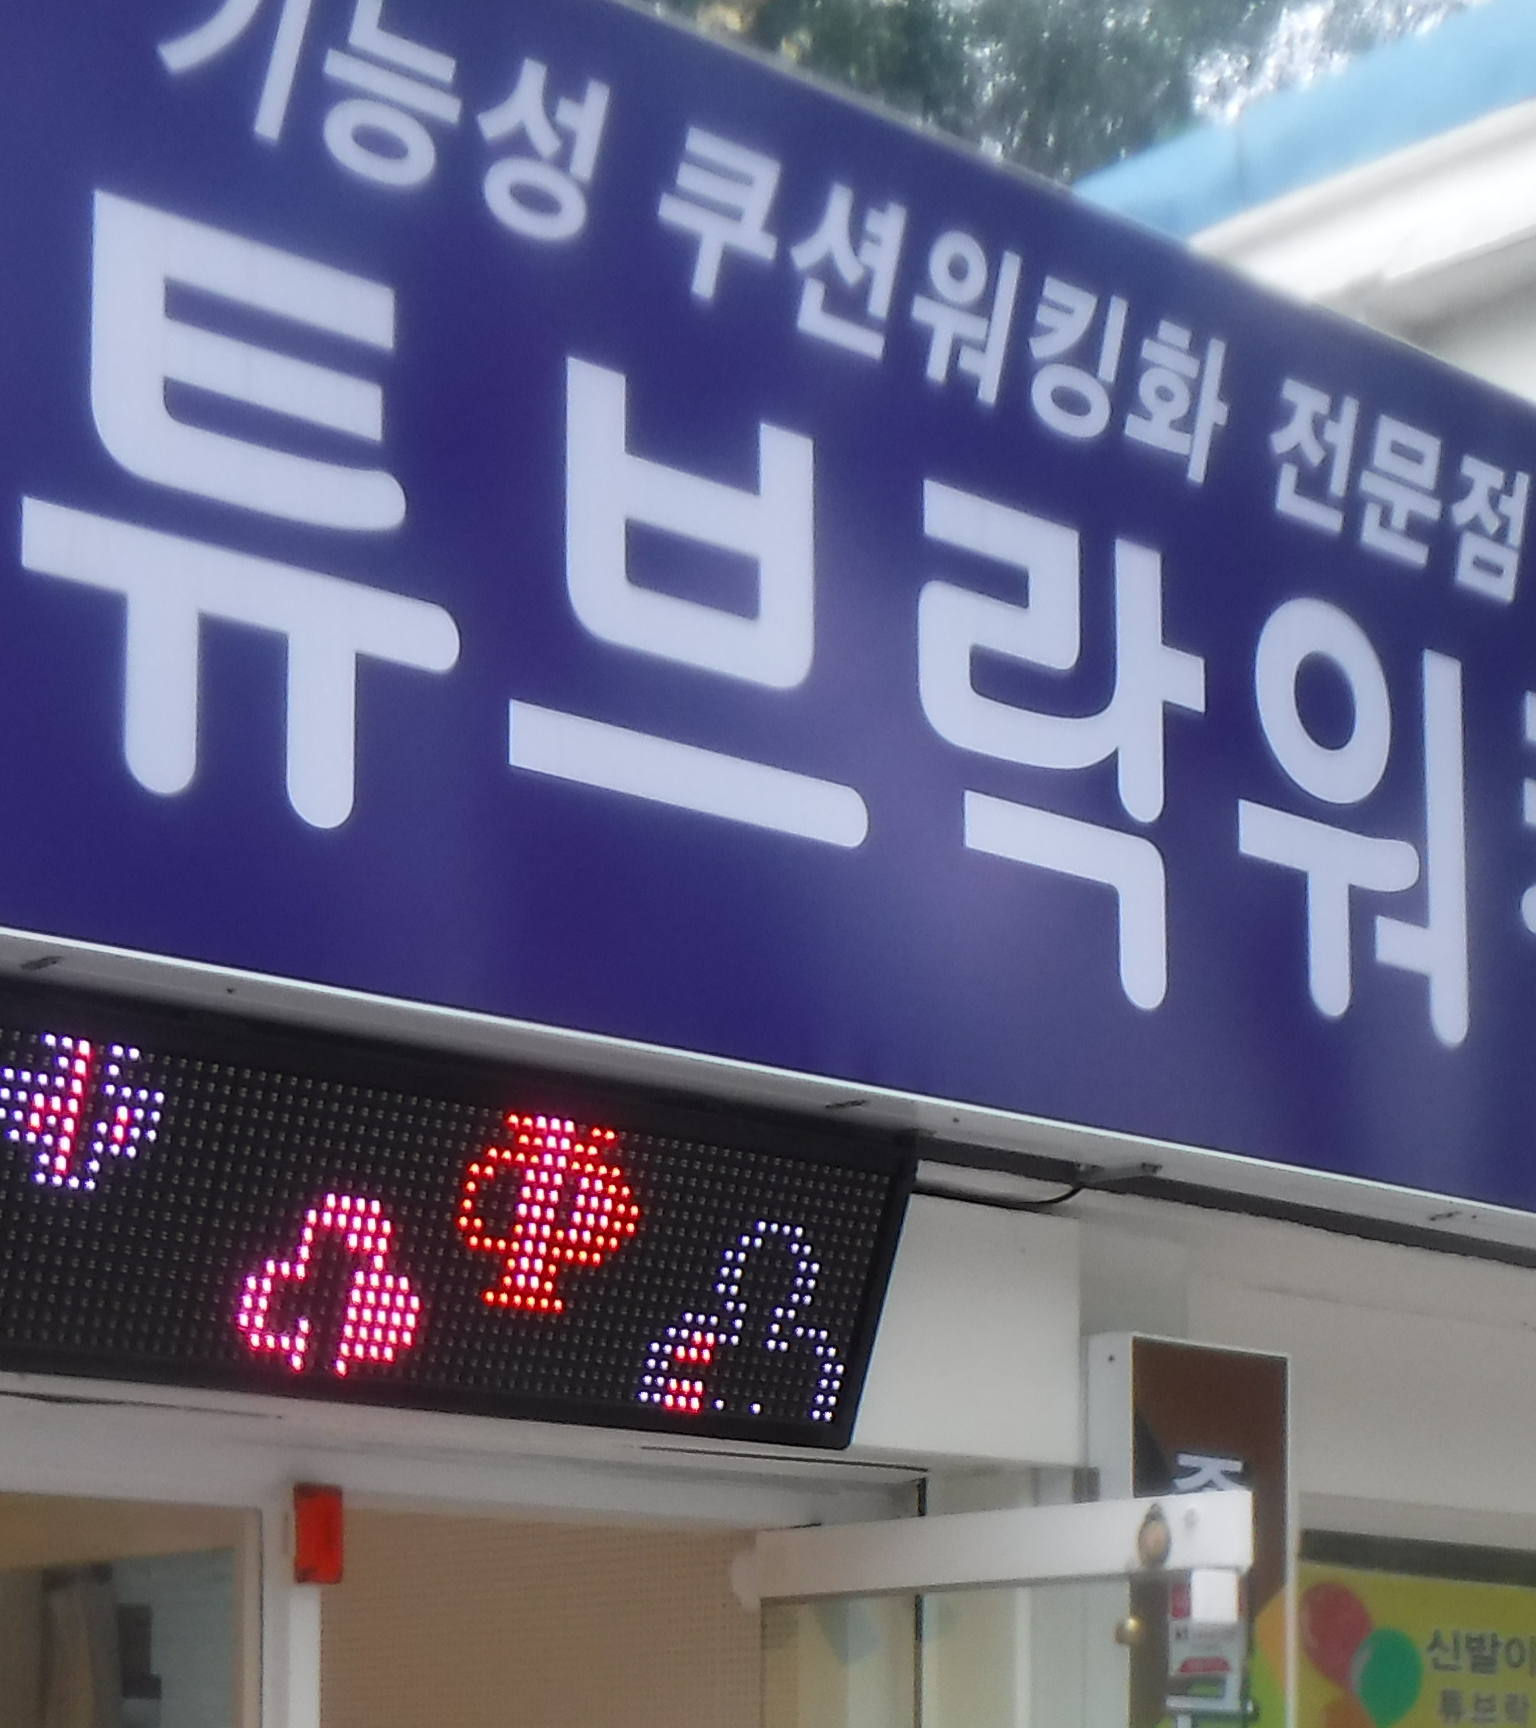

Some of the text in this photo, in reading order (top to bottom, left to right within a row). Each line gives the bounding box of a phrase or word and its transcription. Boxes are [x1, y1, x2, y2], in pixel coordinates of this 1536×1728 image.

[156, 0, 1532, 606] 기능성 쿠션워킹화 전문점
